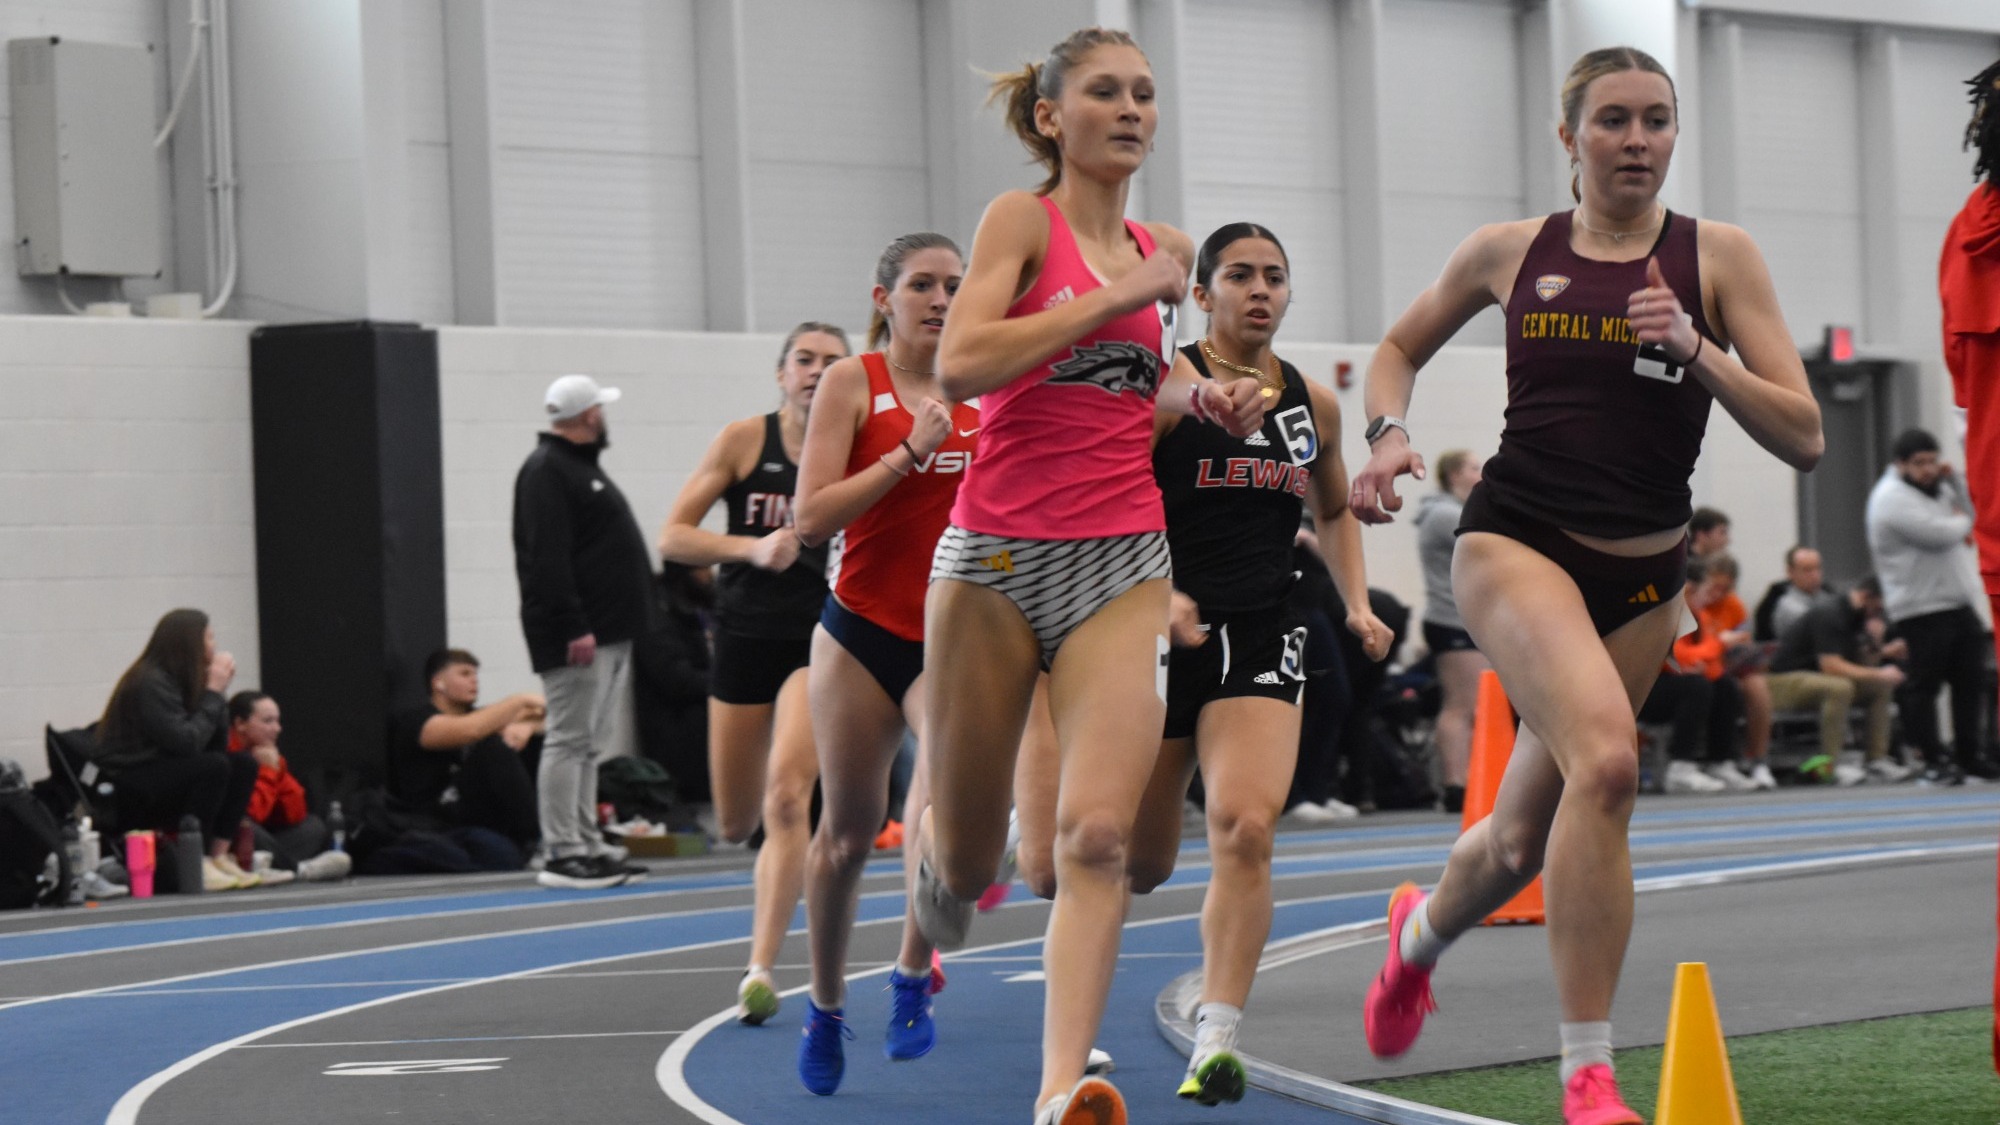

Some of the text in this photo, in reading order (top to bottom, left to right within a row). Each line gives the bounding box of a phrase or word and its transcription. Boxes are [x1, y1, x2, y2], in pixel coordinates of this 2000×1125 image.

[1522, 313, 1590, 339] CENTRAL
[1282, 410, 1315, 460] 5
[1195, 457, 1310, 498] LEWIS
[1283, 630, 1306, 677] 5
